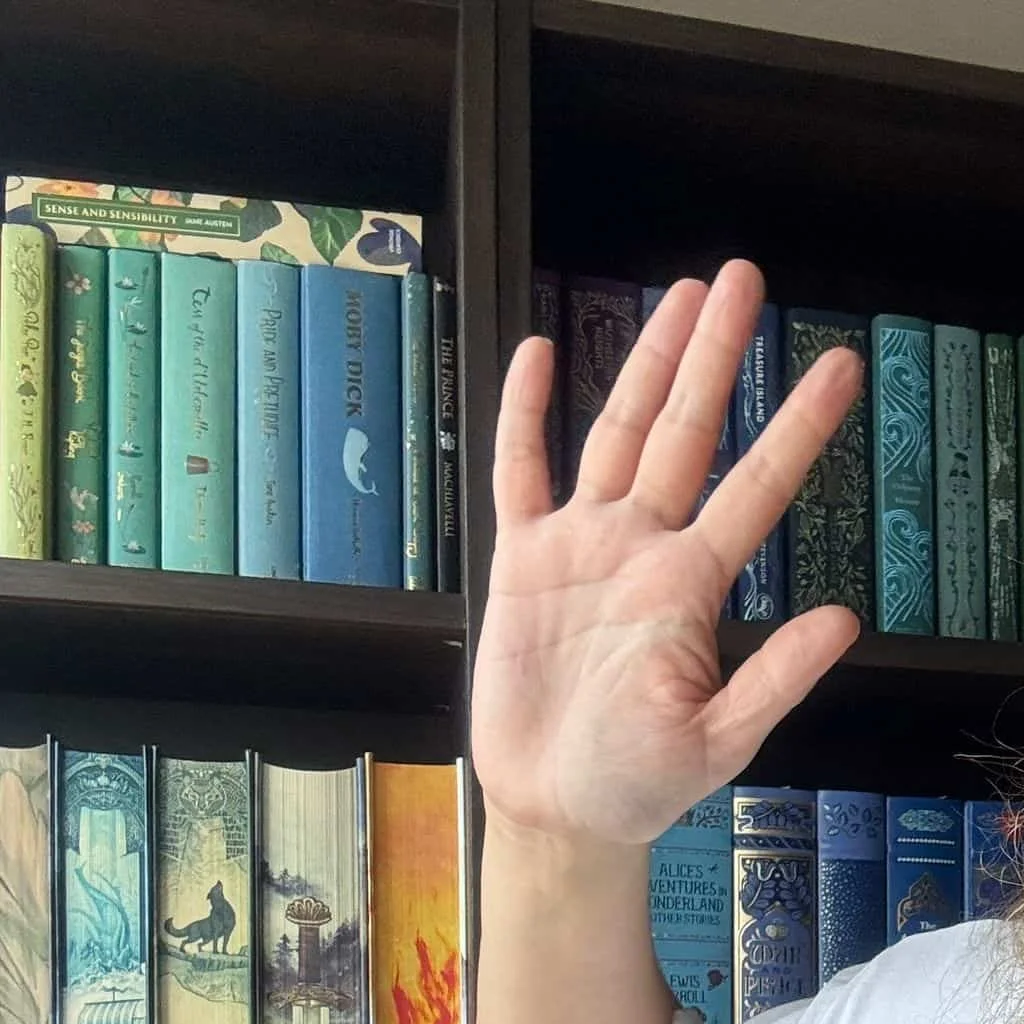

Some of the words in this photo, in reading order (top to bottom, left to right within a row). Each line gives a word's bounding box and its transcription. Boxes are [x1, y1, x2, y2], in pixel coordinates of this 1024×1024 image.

[45, 204, 79, 216] SENSE
[82, 207, 107, 218] AND
[109, 209, 177, 224] SENSIBILITY
[205, 218, 233, 228] AUSTEN
[345, 289, 364, 354] MOBY
[441, 338, 454, 363] THE
[755, 336, 765, 386] TREASURE
[346, 360, 364, 418] DICK
[441, 366, 456, 419] PRINCE
[755, 388, 765, 423] ISLAND
[444, 462, 457, 537] MACHIAVELLI
[759, 544, 768, 585] TEVENSON
[650, 879, 716, 896] VENTURES
[670, 973, 700, 988] EWIS
